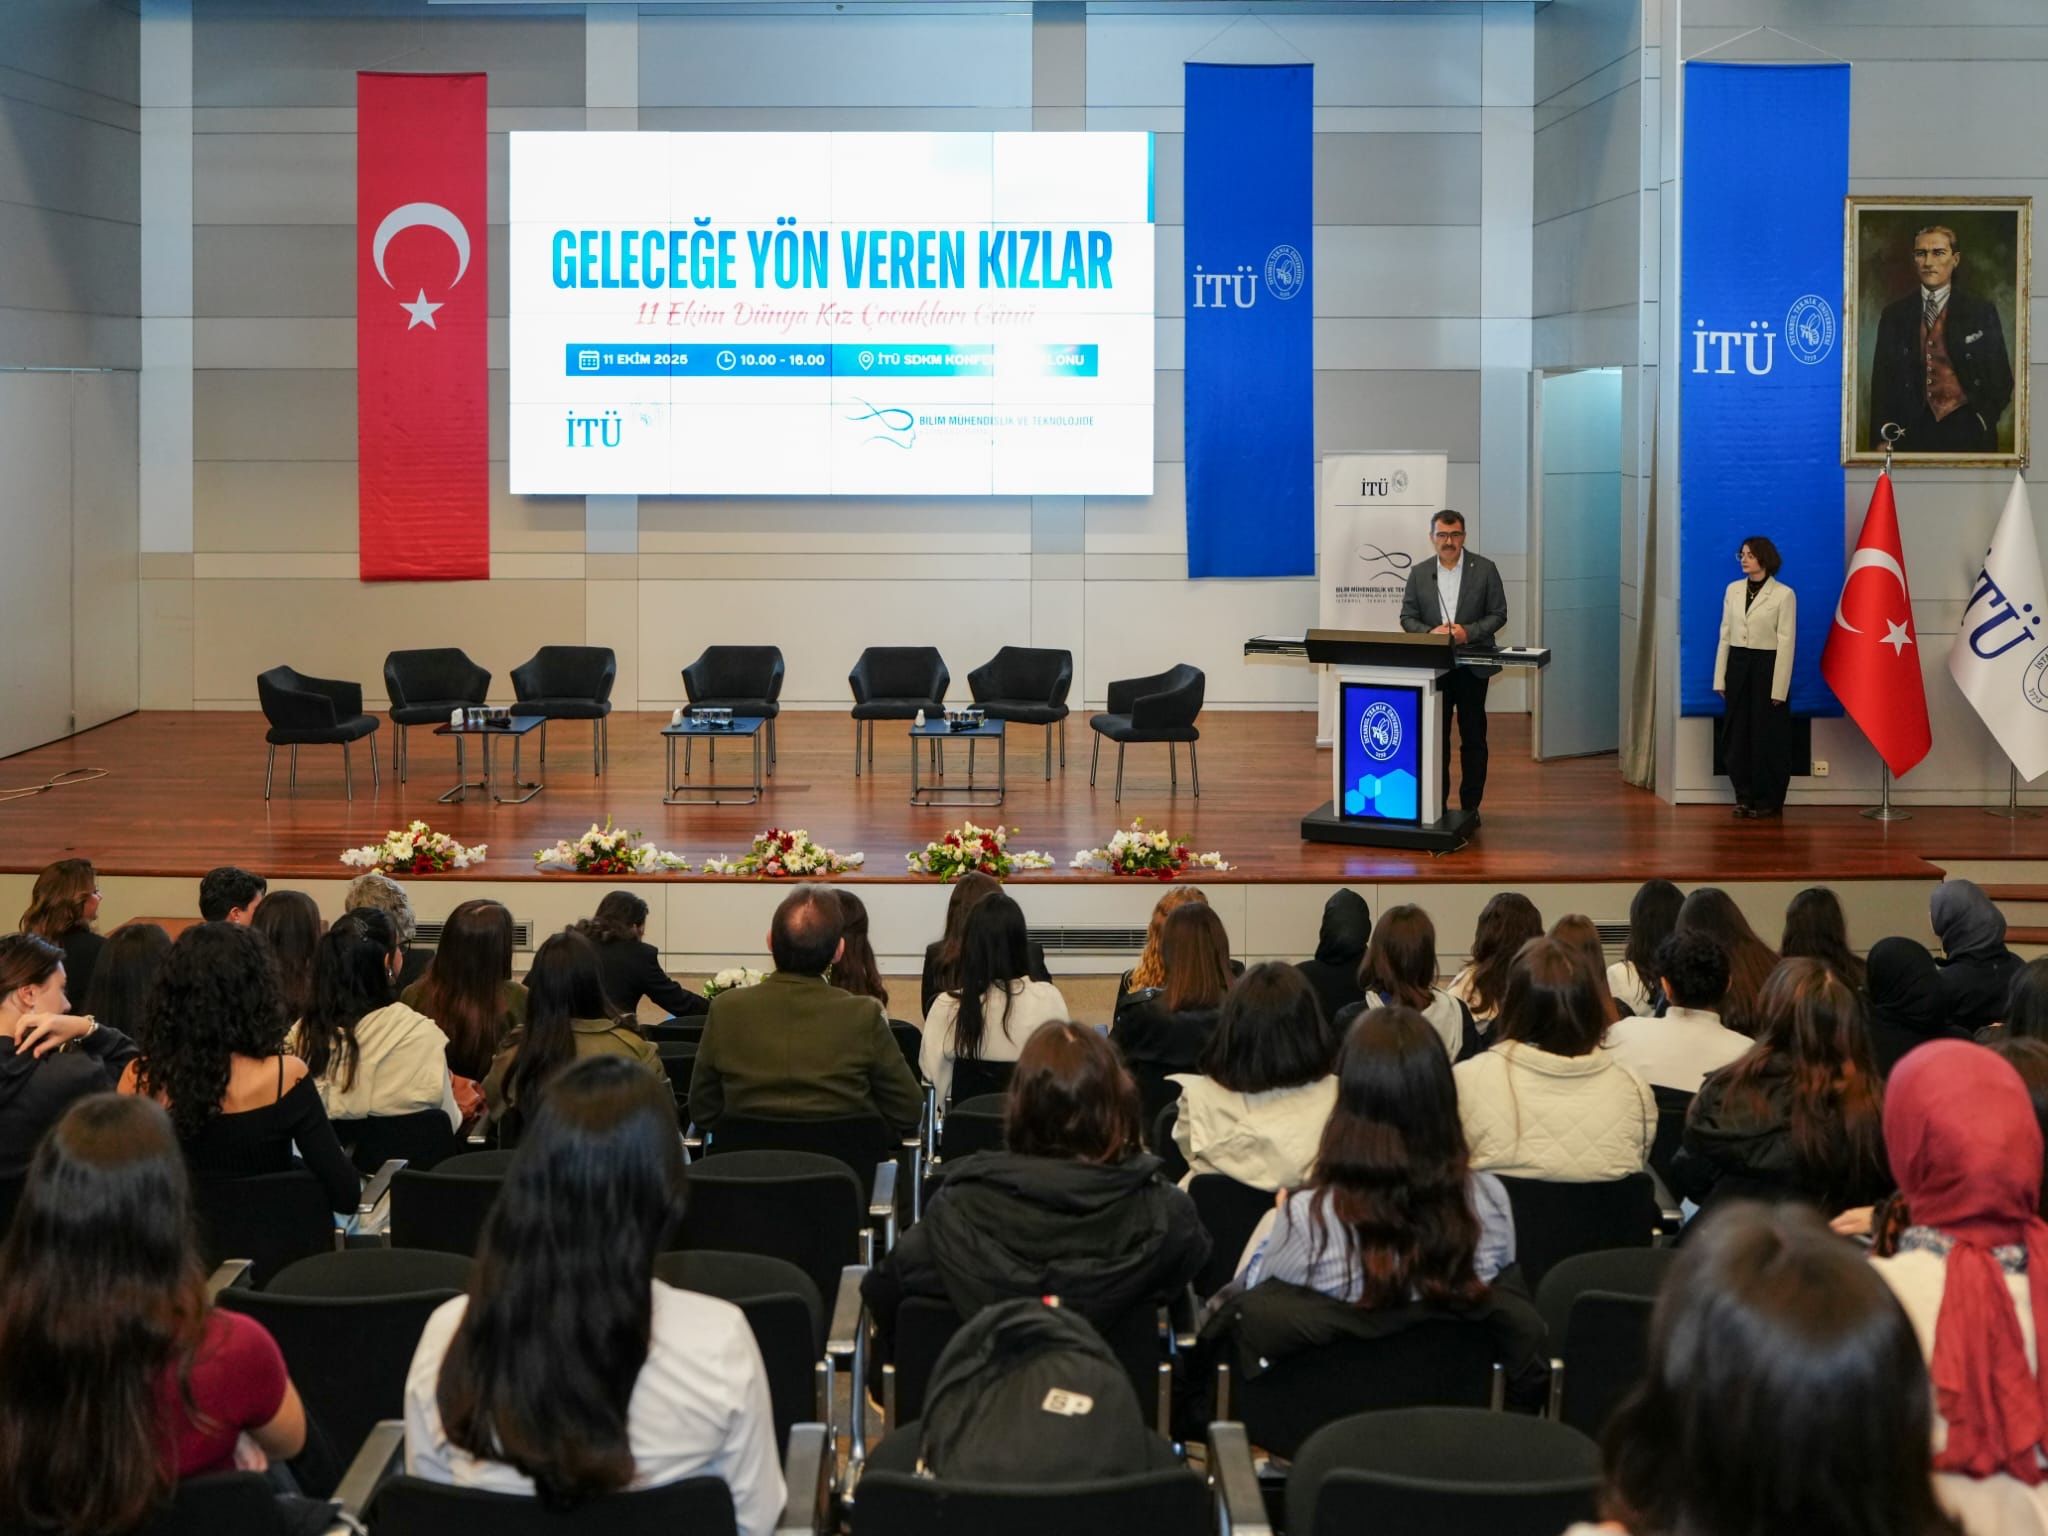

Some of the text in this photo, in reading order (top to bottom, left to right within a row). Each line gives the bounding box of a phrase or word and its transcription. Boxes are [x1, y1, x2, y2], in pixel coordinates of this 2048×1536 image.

[553, 217, 1113, 289] GELECEĞE YÖN VEREN KIZLAR
[1193, 265, 1258, 308] İTÜ
[635, 302, 660, 325] 11
[667, 300, 726, 327] Ekim
[734, 302, 809, 335] Dünya
[816, 302, 855, 326] Kız
[862, 300, 967, 331] Çocukları
[603, 351, 688, 365] 11 EKİM 2025
[741, 354, 776, 365] 10.00
[878, 352, 900, 365] İTÜ
[904, 354, 942, 366] SDKM
[1692, 319, 1777, 375] İTÜ
[565, 410, 623, 448] İTÜ
[1361, 478, 1389, 497] İTÜ
